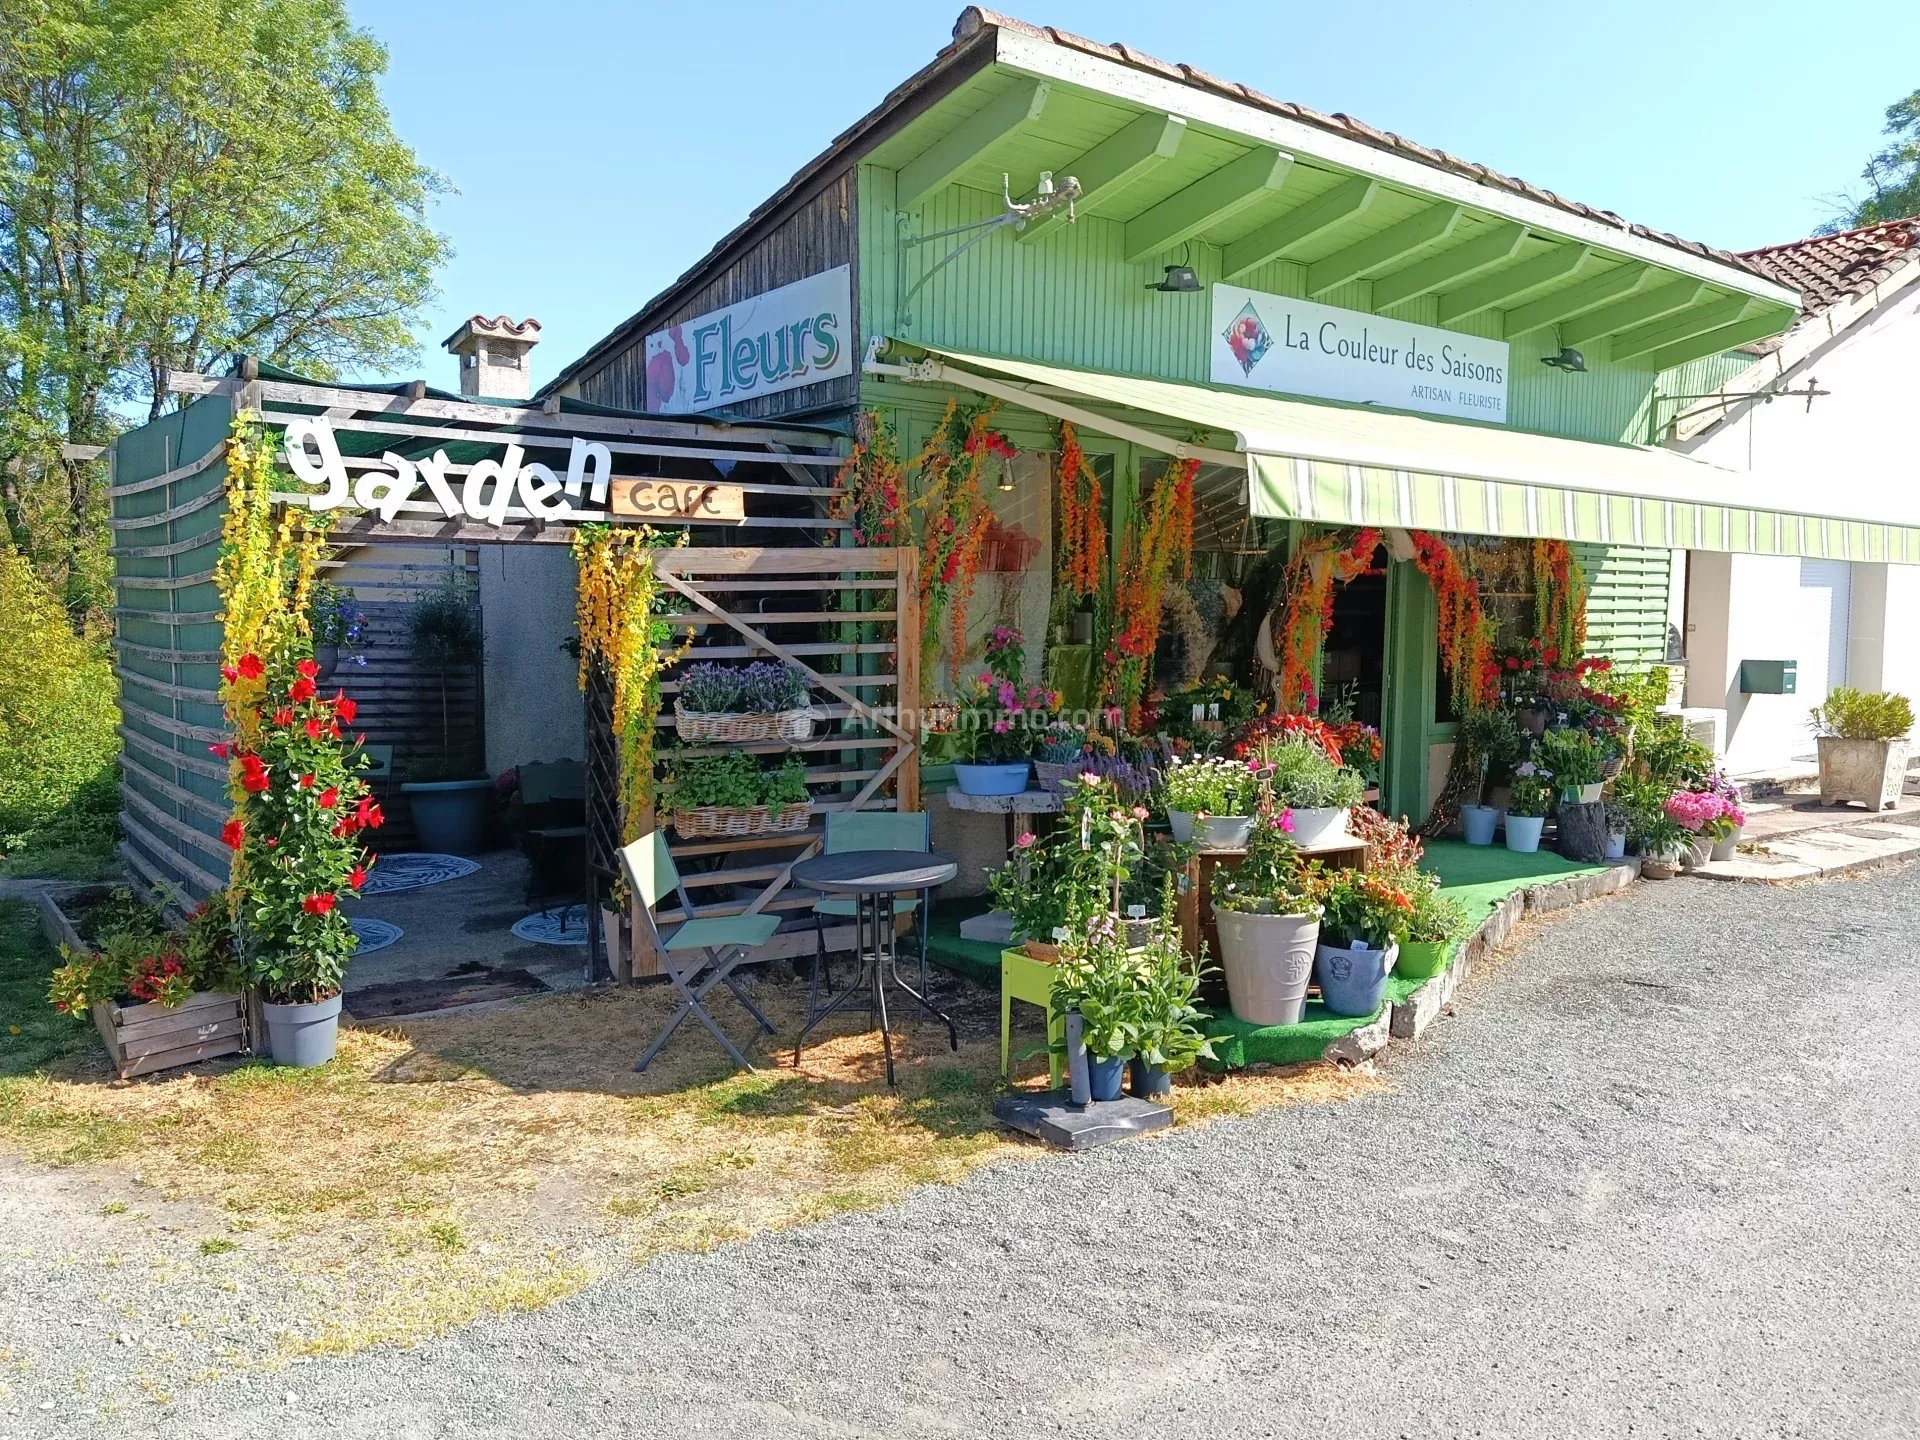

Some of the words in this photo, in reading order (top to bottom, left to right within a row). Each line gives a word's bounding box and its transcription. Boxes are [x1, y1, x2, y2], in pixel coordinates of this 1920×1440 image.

[693, 312, 839, 403] Fleurs
[1285, 314, 1310, 351] La
[1319, 321, 1399, 366] Couleur
[1405, 337, 1434, 372] des
[1441, 344, 1503, 384] Saisons
[1411, 384, 1452, 402] ARTISAN
[1459, 391, 1502, 411] FLEURISTE
[284, 416, 612, 528] garden
